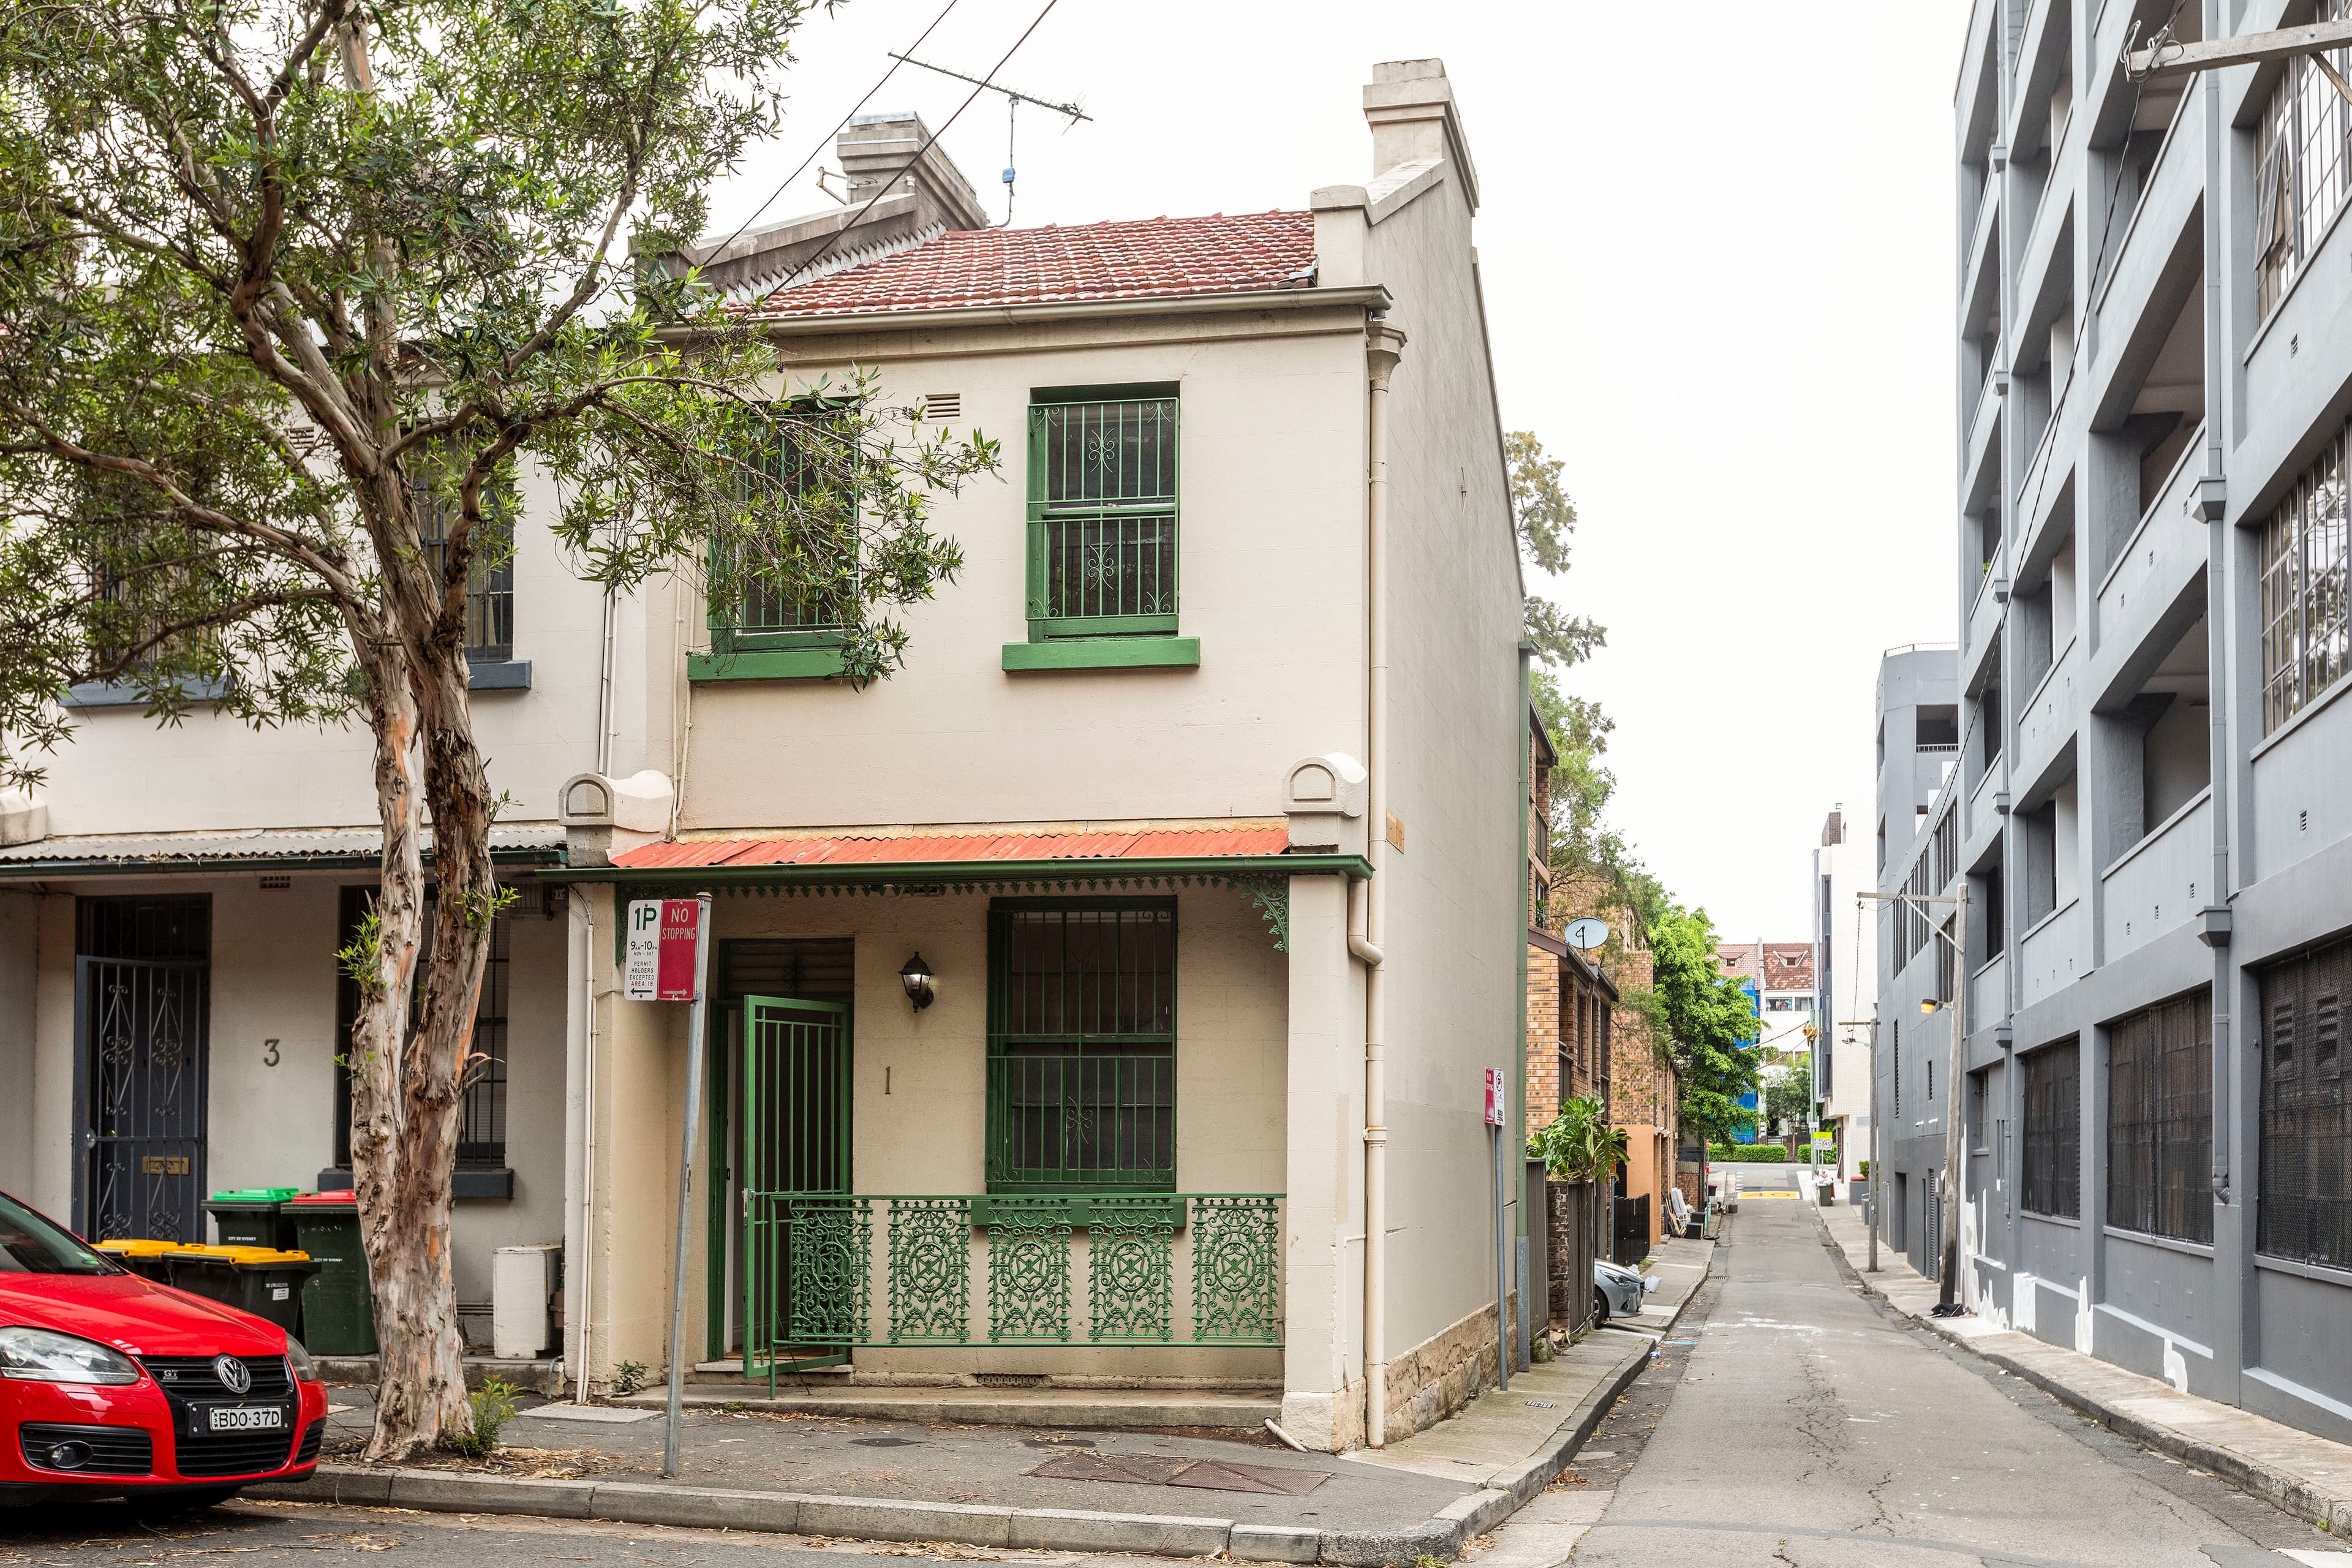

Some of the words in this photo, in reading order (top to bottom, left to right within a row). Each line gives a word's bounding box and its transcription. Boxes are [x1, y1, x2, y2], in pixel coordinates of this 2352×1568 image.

[635, 908, 657, 930] 1P
[671, 908, 689, 922] NO
[662, 927, 696, 940] STOPPING
[263, 1038, 280, 1067] 3
[884, 1066, 891, 1095] 1
